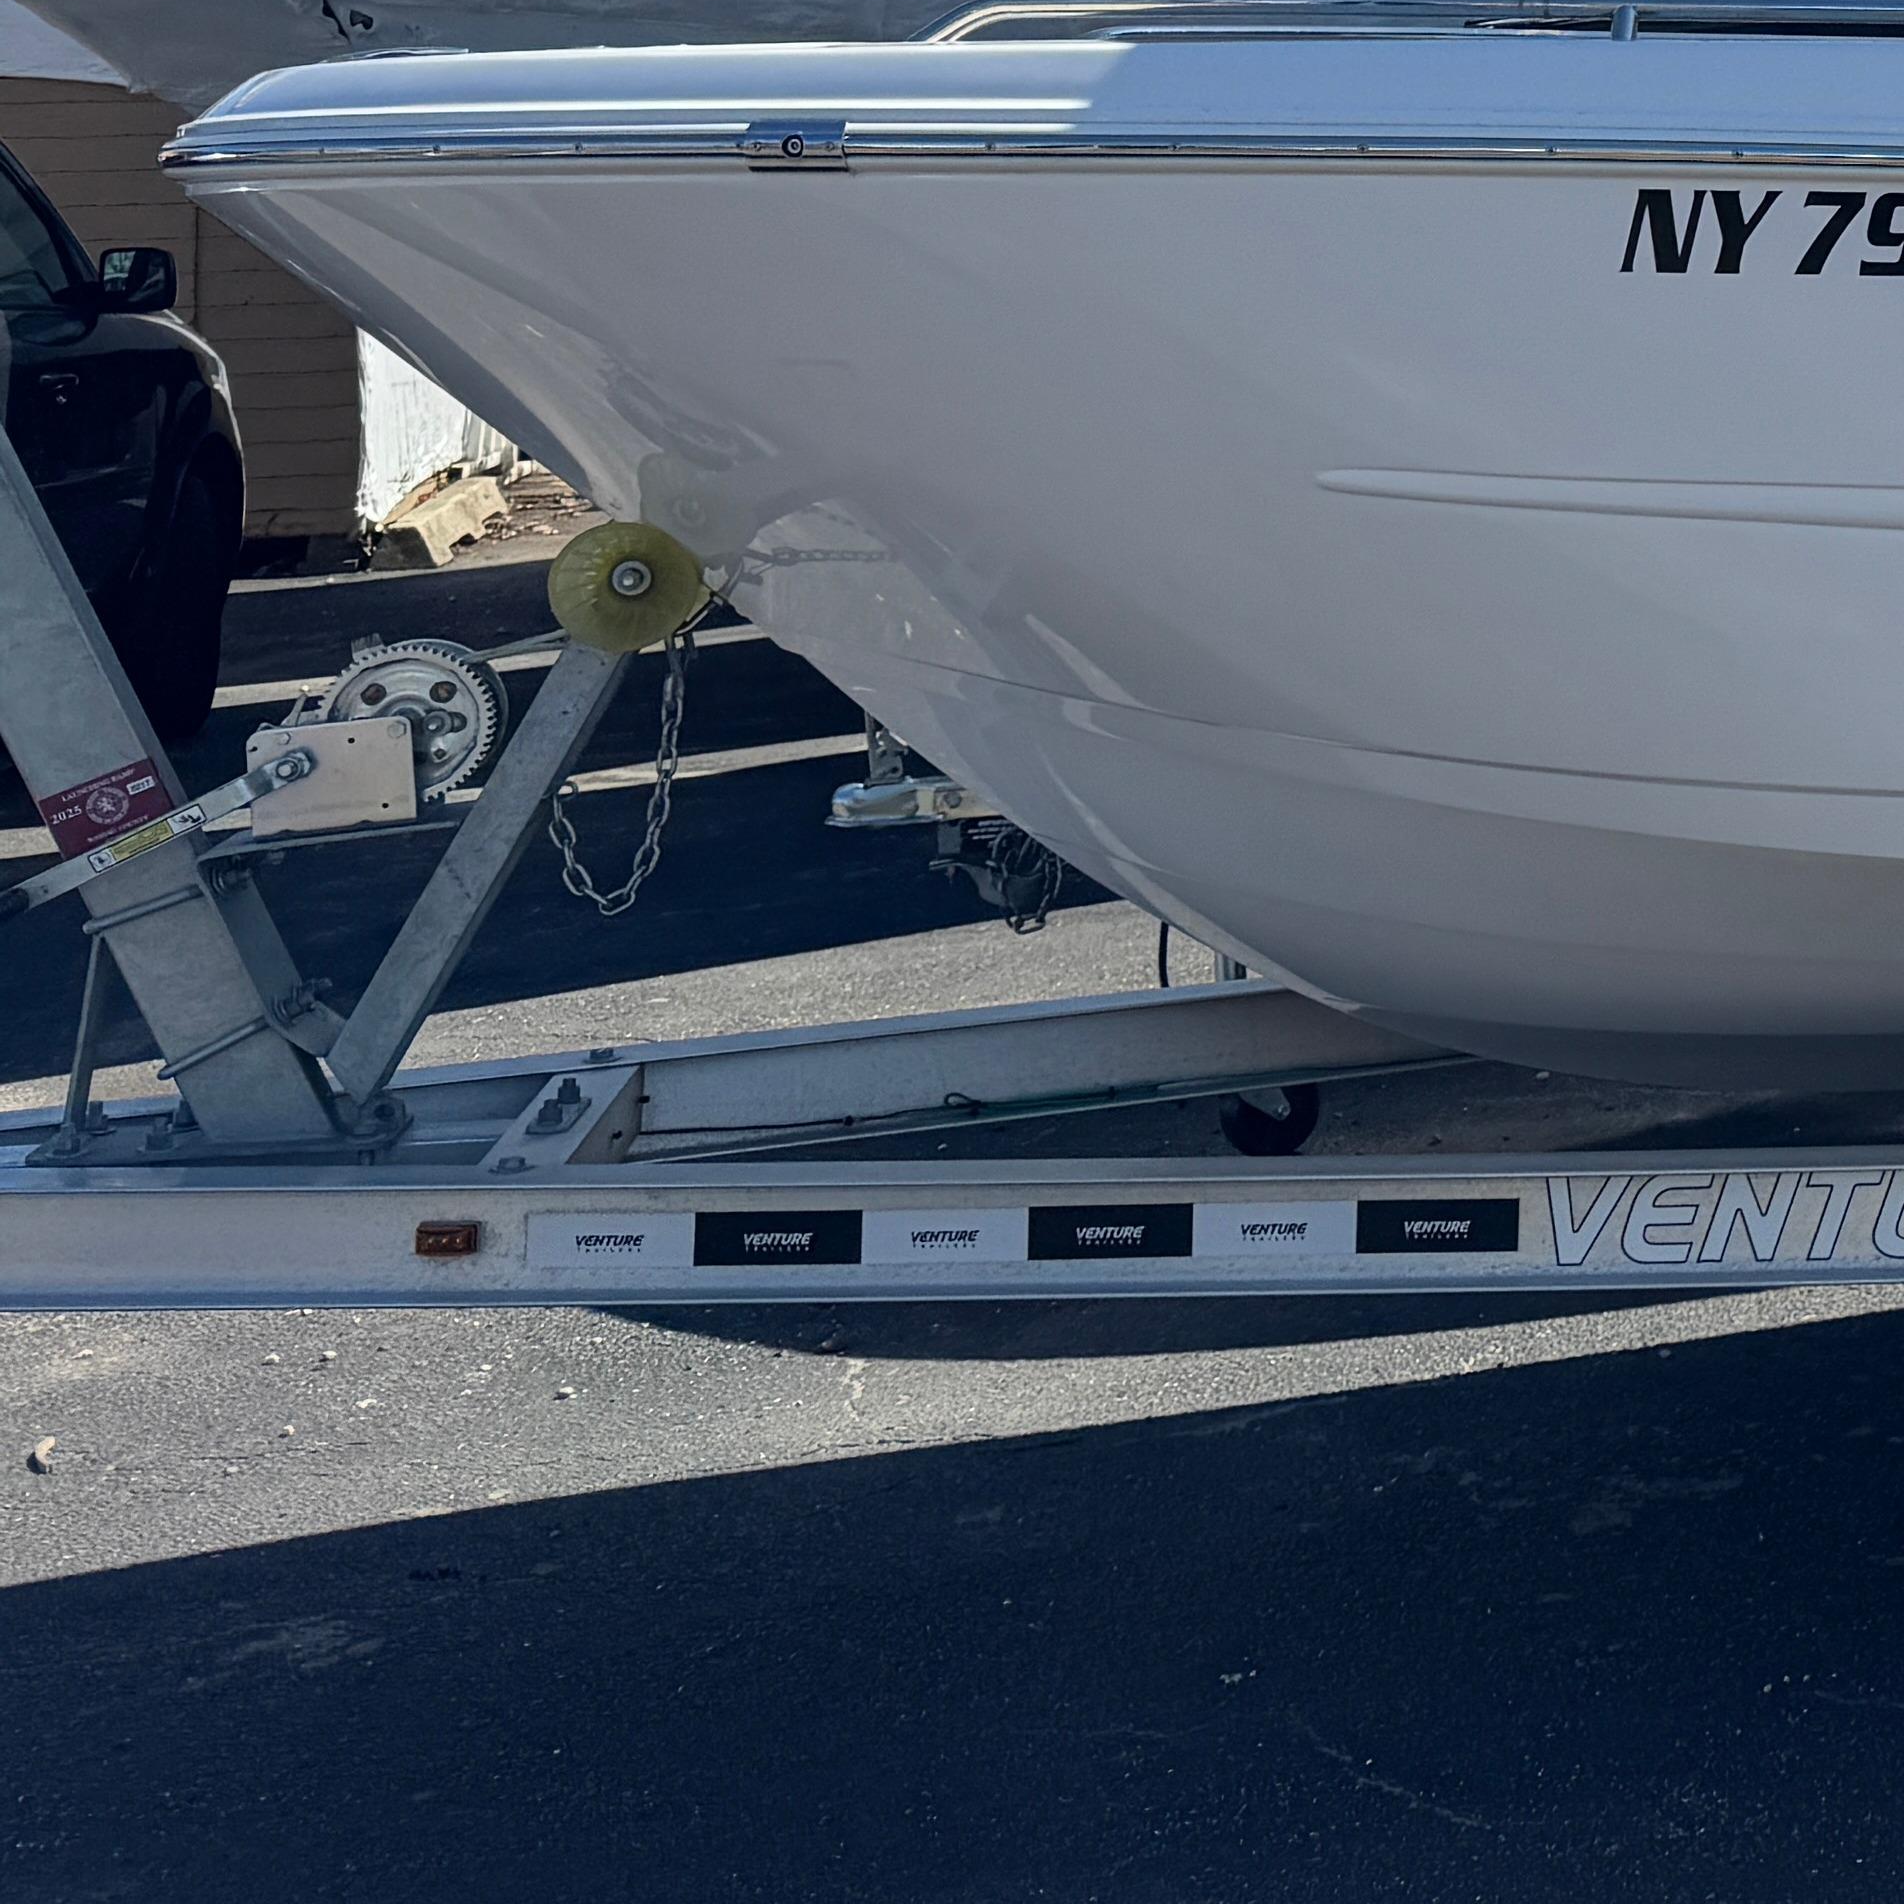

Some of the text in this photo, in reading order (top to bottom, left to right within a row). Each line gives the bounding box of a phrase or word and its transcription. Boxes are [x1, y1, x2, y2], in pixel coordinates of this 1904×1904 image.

[1619, 188, 1783, 275] NY
[51, 805, 82, 824] 2025
[1076, 1226, 1145, 1239] VENTURE
[1241, 1223, 1308, 1235] VENTURE
[1404, 1220, 1471, 1233] VENTURE
[576, 1234, 645, 1246] VENTURE
[743, 1232, 813, 1245] VENTURE
[911, 1230, 980, 1243] VENTURE
